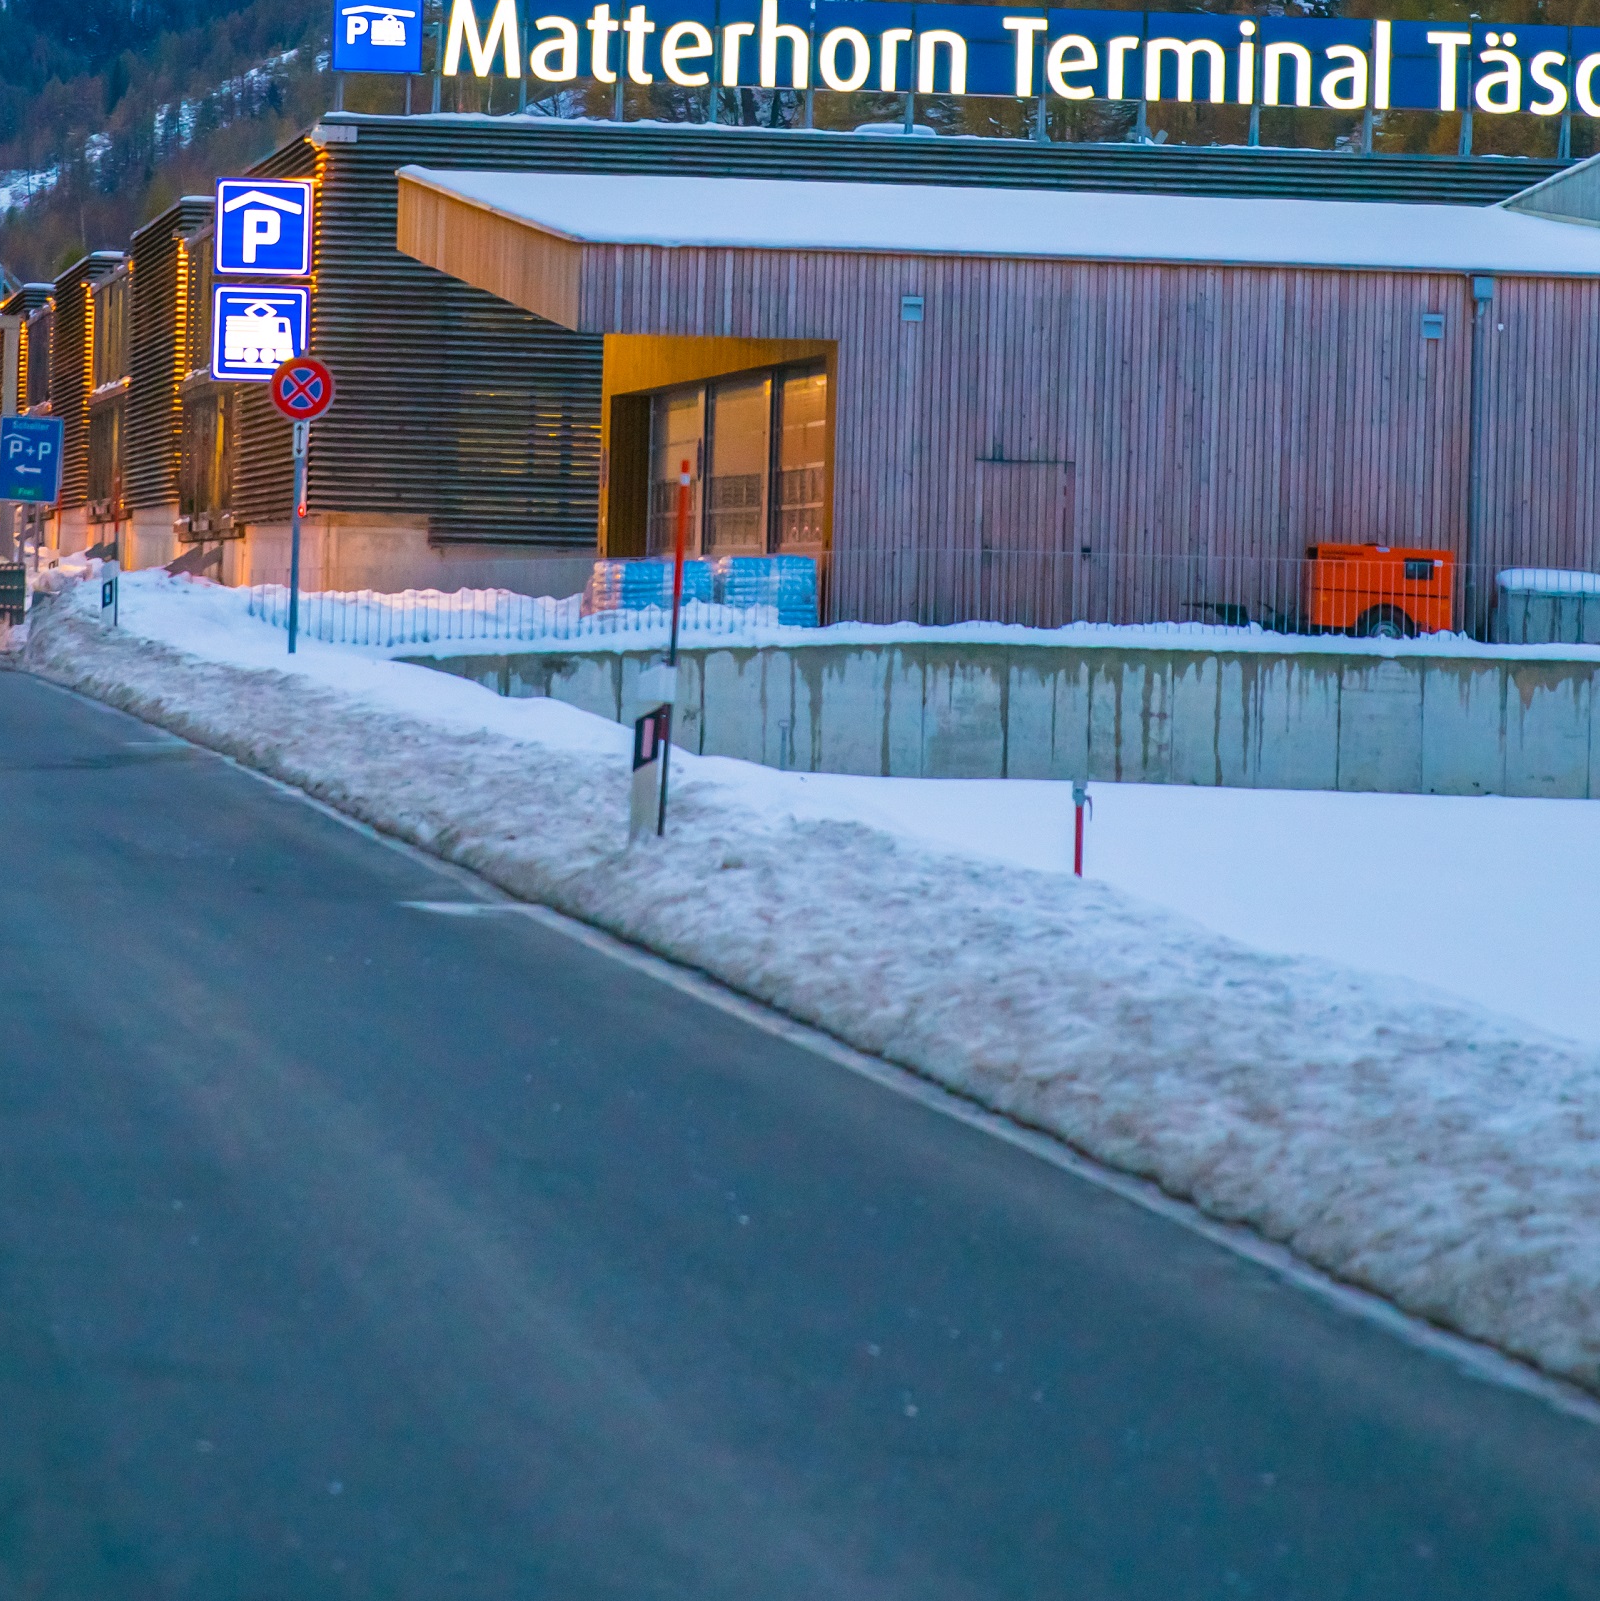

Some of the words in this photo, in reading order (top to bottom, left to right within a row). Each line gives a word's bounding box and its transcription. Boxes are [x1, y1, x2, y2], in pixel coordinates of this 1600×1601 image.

[346, 15, 369, 45] P
[1003, 16, 1392, 111] Terminal
[242, 209, 281, 264] P
